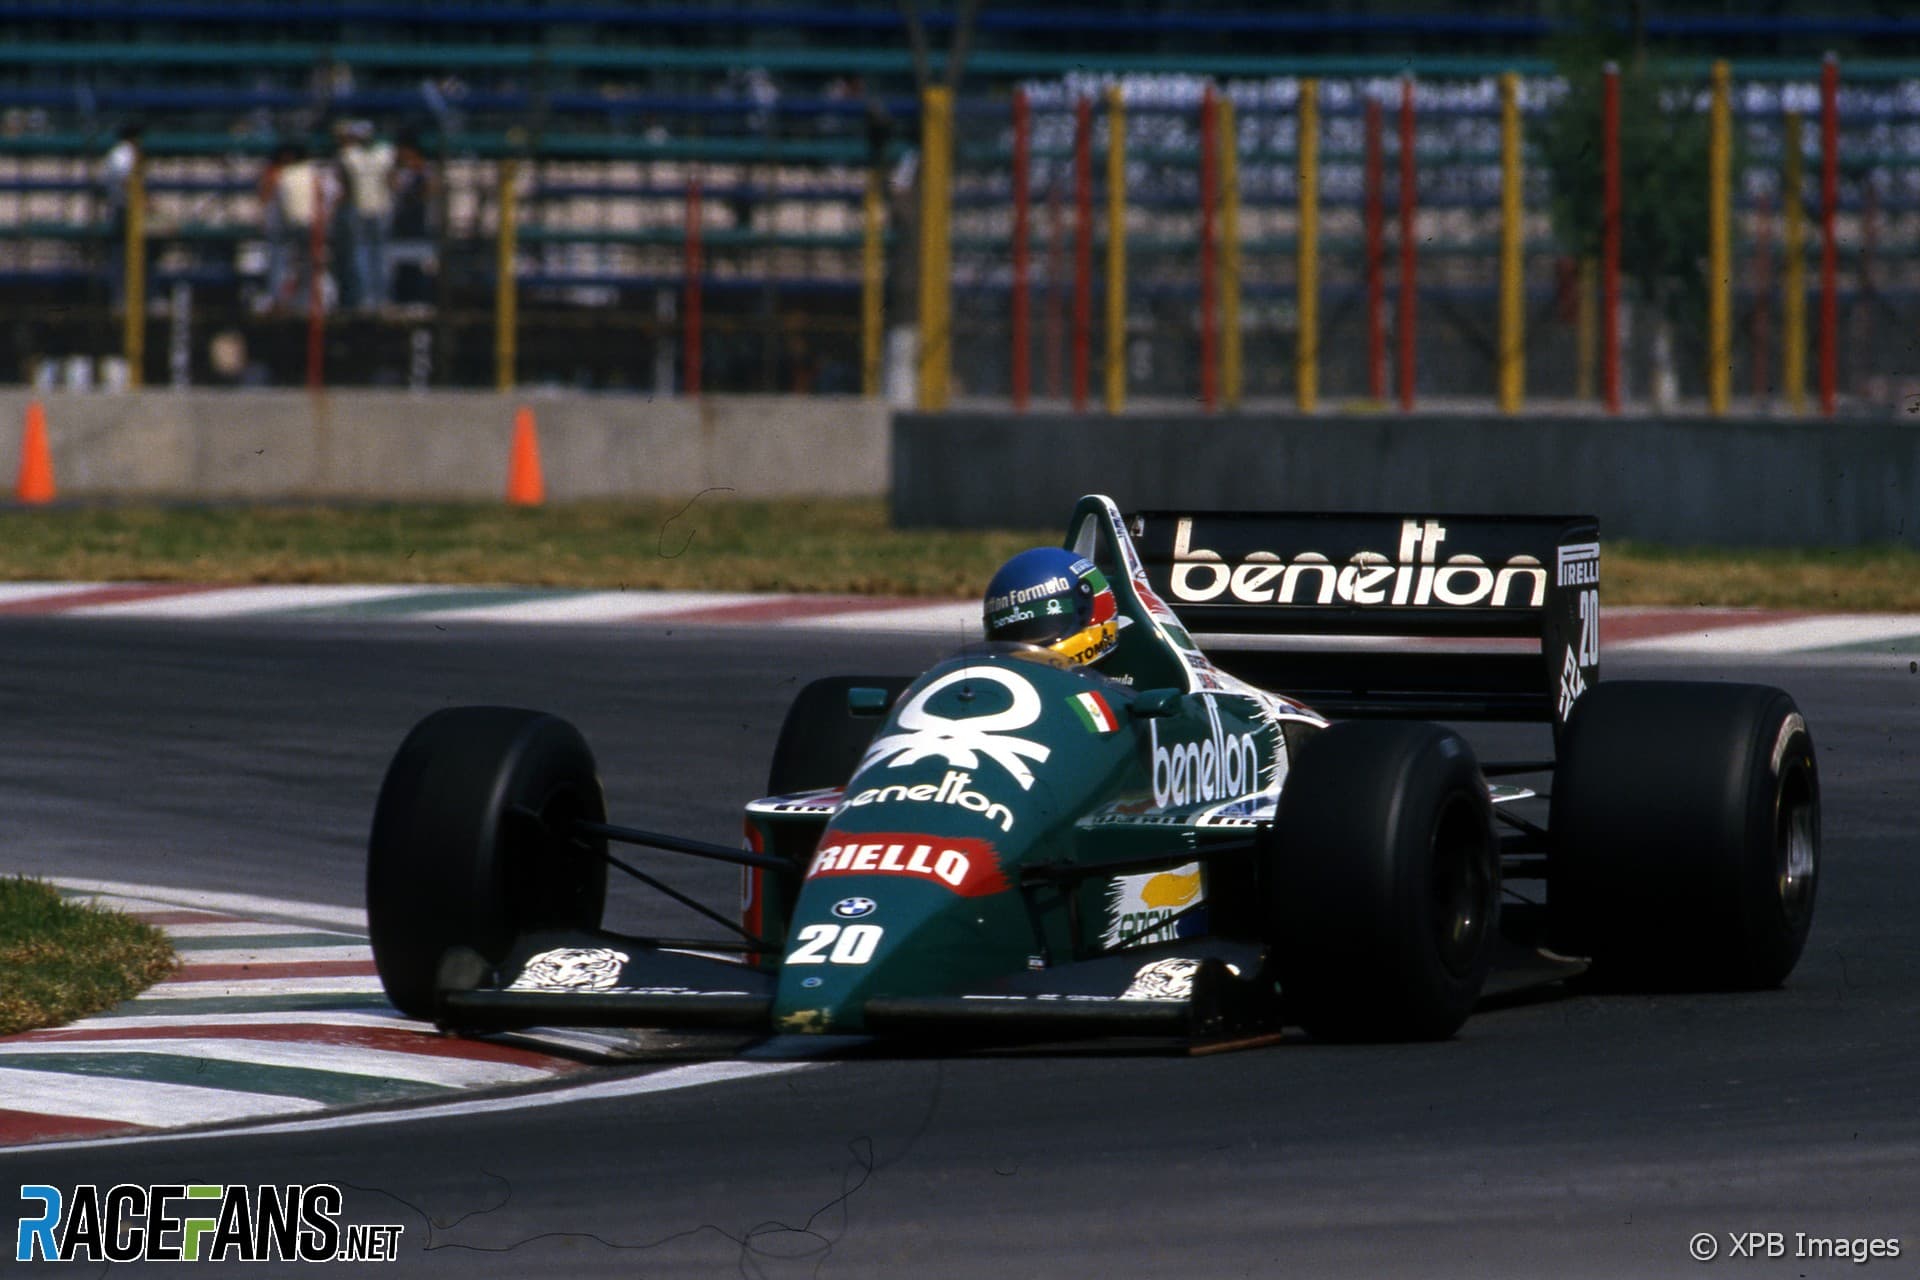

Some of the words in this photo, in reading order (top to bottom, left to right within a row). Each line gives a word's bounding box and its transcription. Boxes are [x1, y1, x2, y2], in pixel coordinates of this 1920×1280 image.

[1169, 517, 1547, 606] benetton
[1558, 543, 1600, 587] PIRELLI
[1579, 589, 1599, 667] 20
[1149, 692, 1258, 809] benetton
[806, 843, 970, 886] RIELLO
[785, 924, 884, 965] 20
